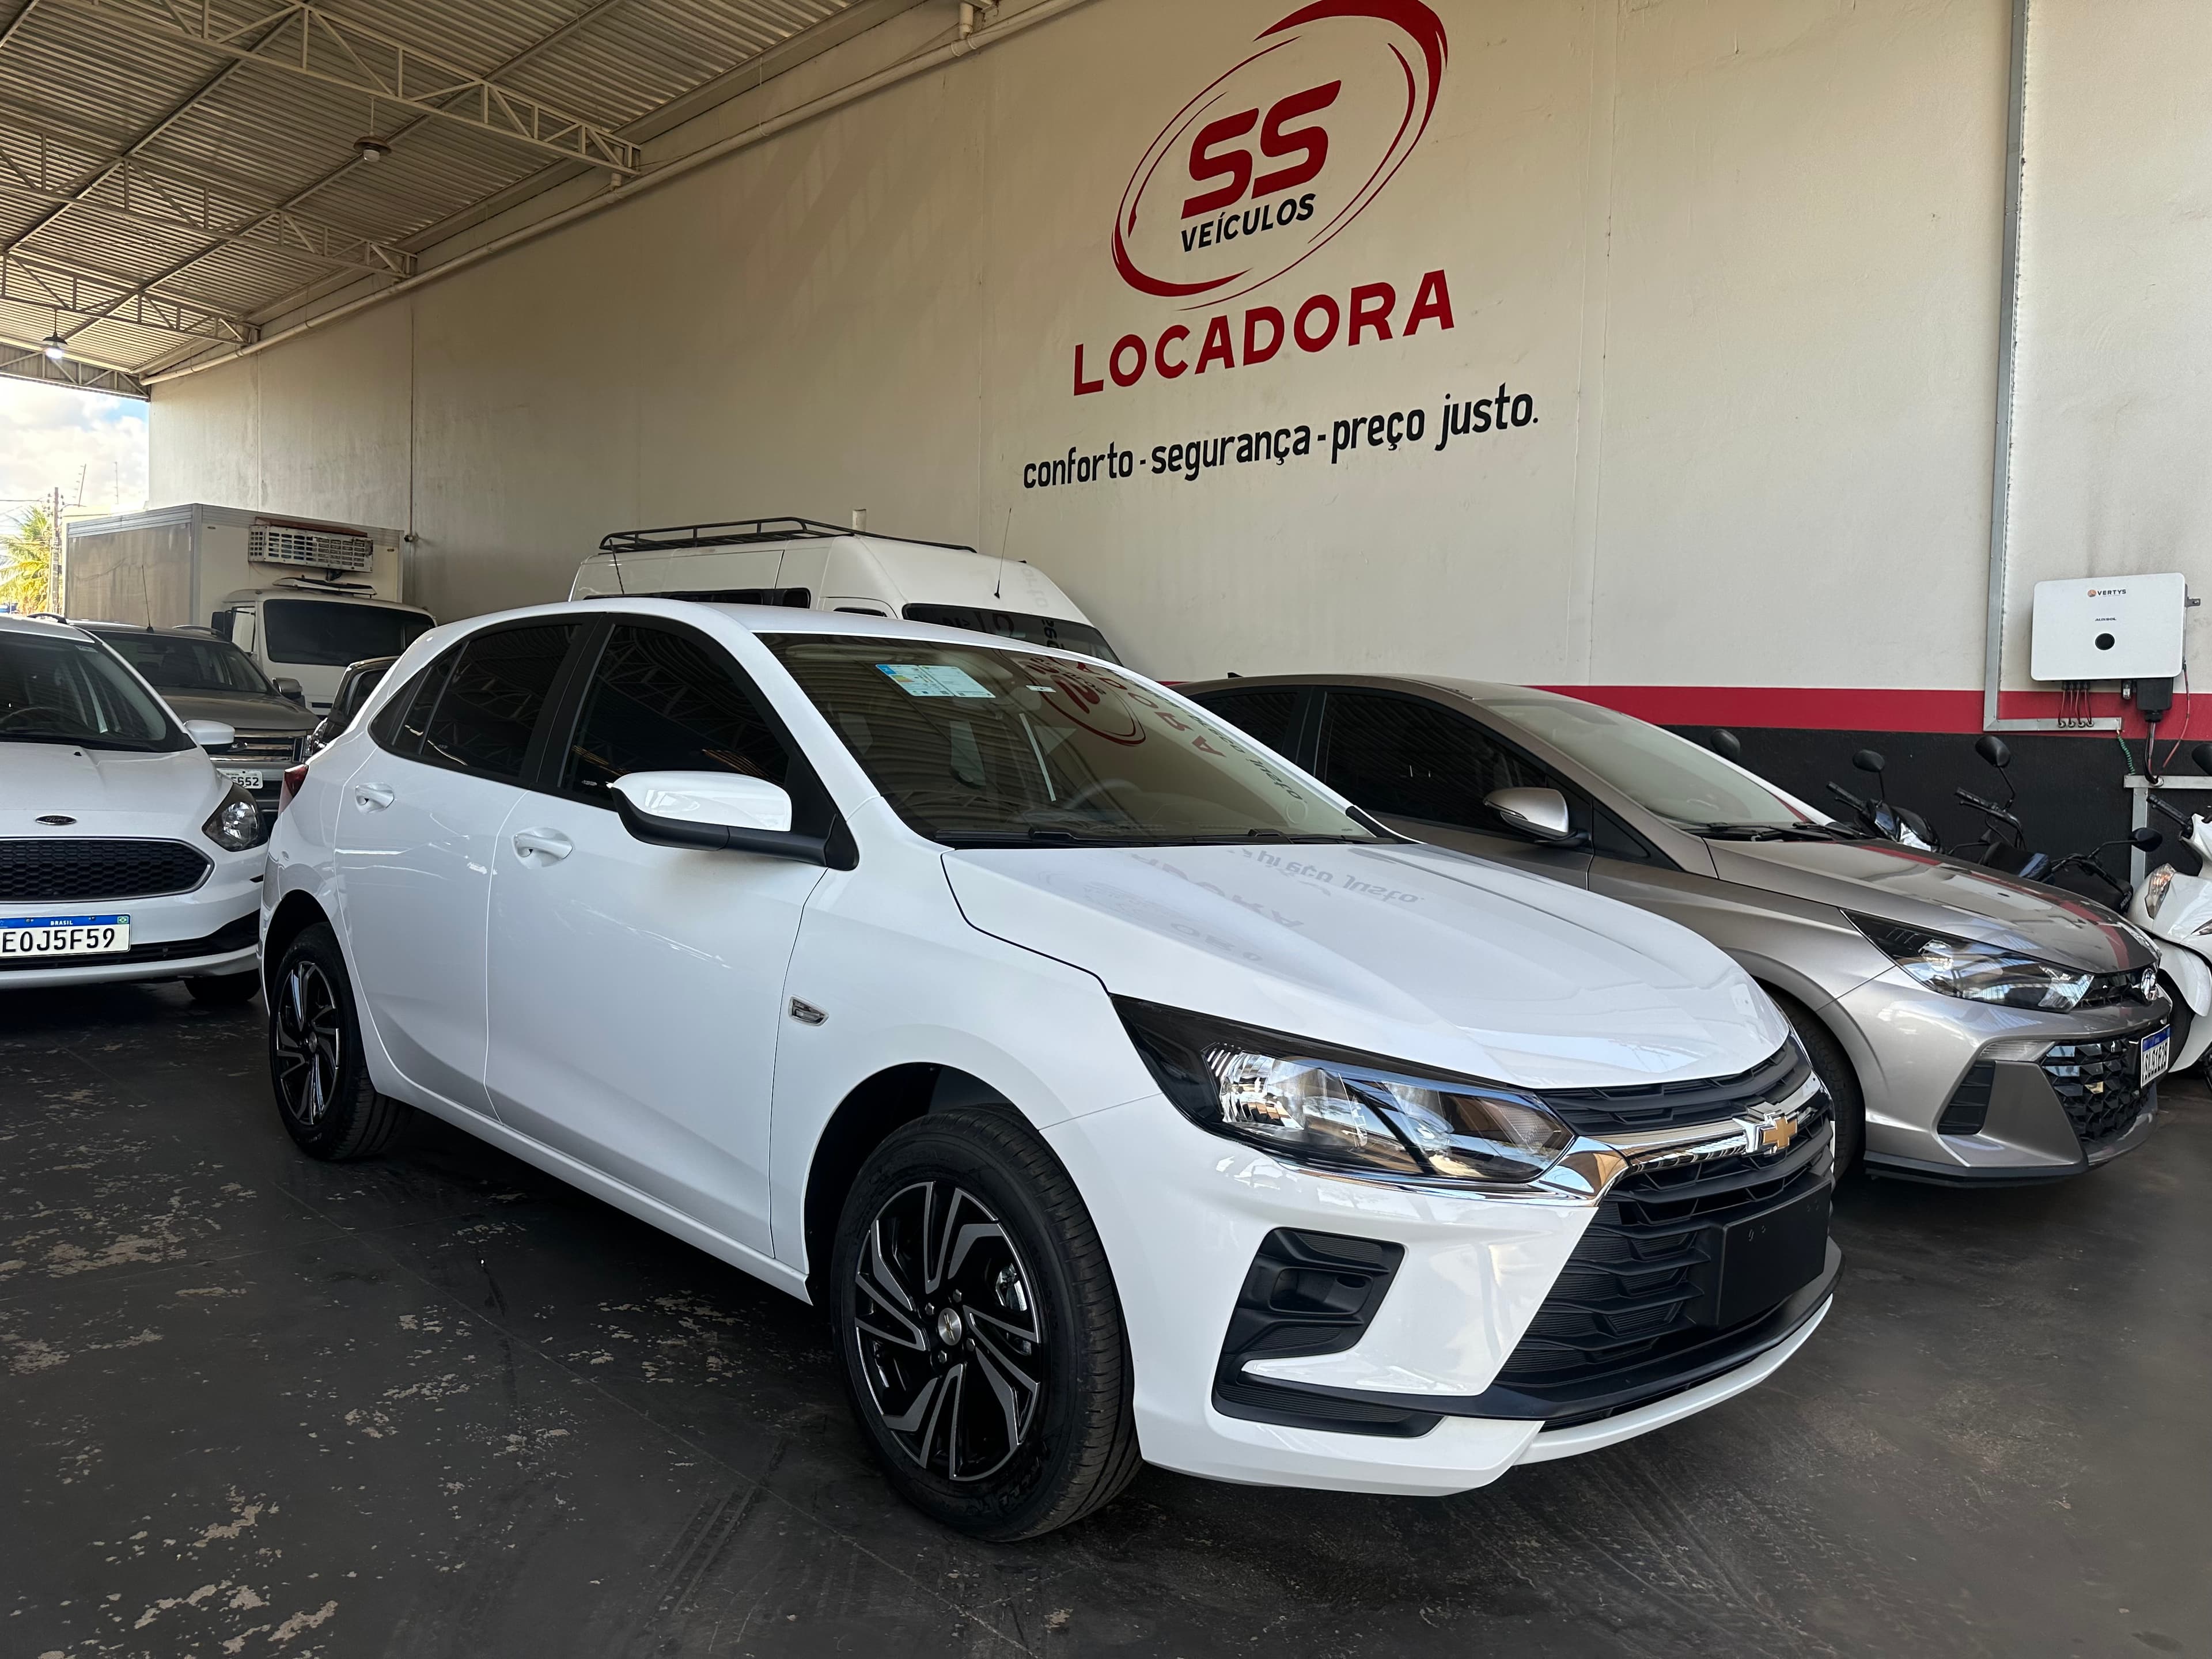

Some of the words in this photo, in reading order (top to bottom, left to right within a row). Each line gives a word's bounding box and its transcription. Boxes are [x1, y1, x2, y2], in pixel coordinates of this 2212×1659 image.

[1181, 79, 1341, 219] SS
[1181, 193, 1316, 252] VEÍCULOS
[1074, 270, 1454, 396] LOCADORA
[1024, 441, 1133, 488] conforto
[1151, 425, 1310, 482] segurança
[1331, 409, 1425, 464] preço
[1434, 382, 1539, 451] justo.
